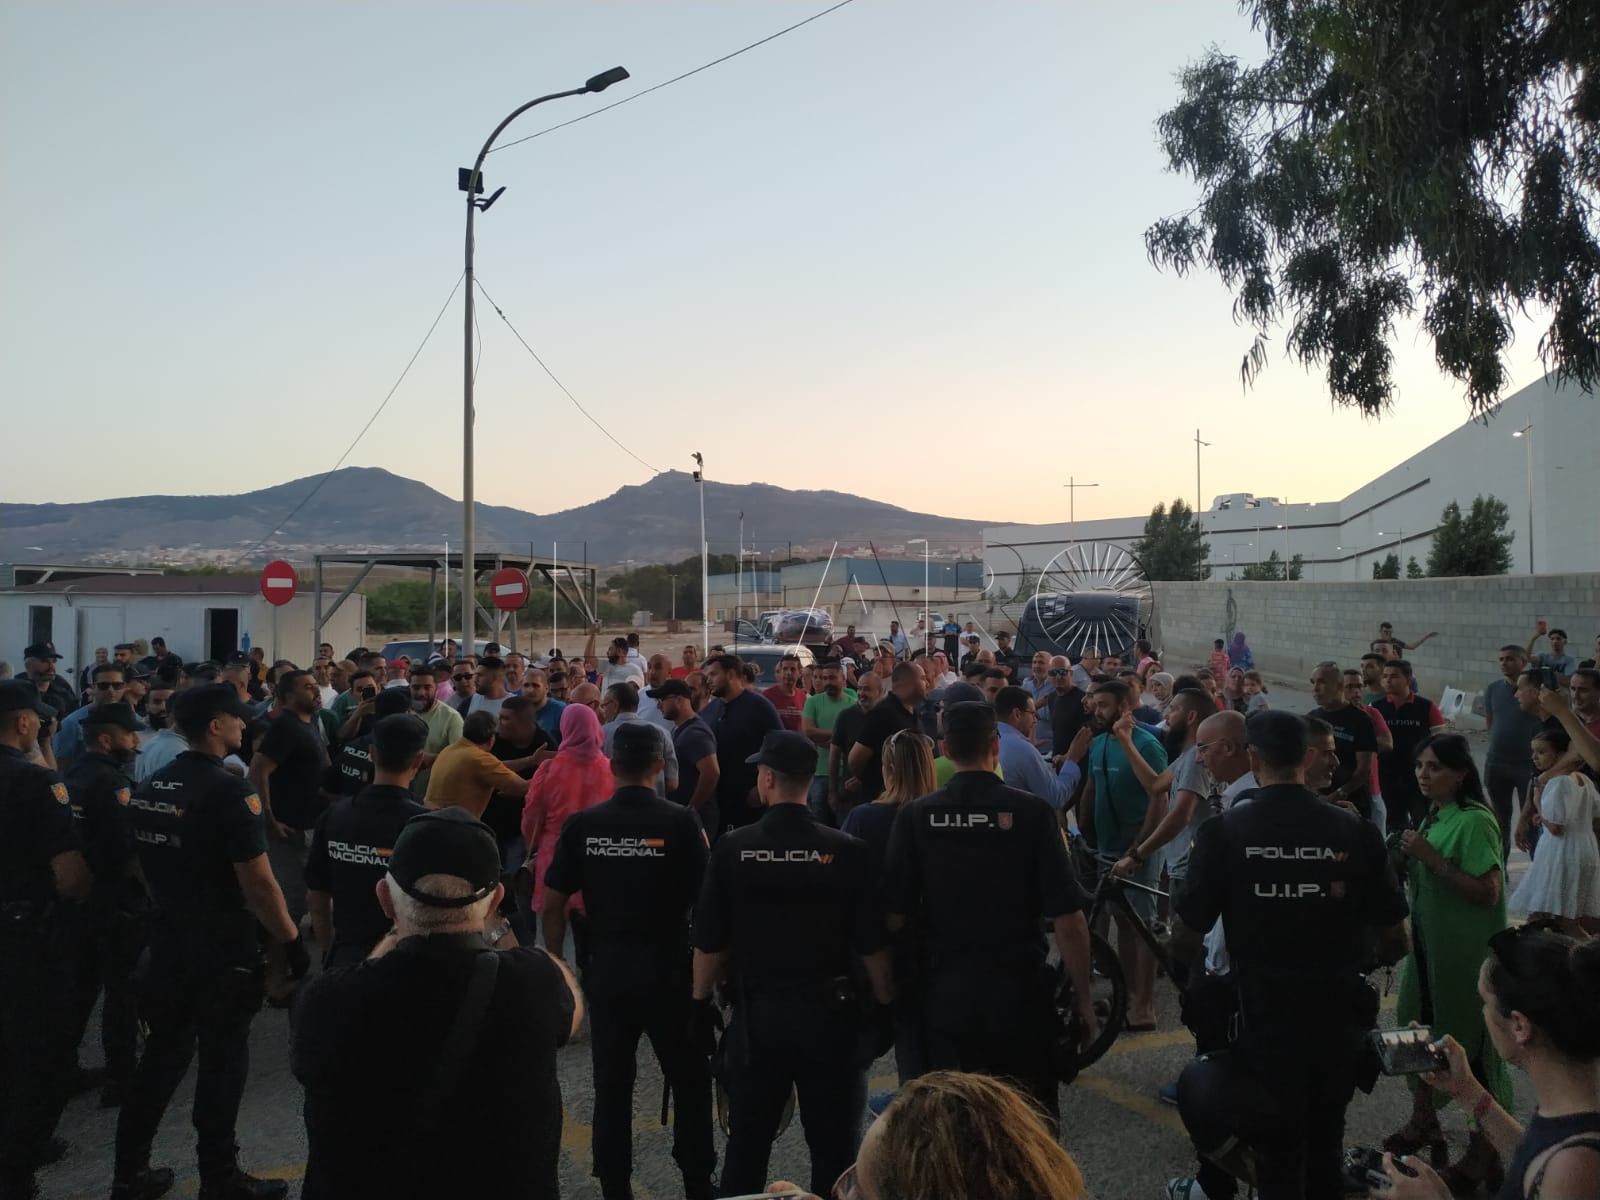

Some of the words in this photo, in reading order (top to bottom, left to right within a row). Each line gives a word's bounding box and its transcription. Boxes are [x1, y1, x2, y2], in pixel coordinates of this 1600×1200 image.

[929, 813, 995, 828] U.I.P.
[328, 840, 378, 856] POLICIA
[586, 837, 649, 848] POLICIA
[328, 850, 391, 867] NACIONAL
[586, 847, 665, 857] NACIONAL
[740, 850, 822, 862] POLICIA
[1245, 846, 1337, 861] POLICIA
[1254, 883, 1327, 898] U.I.P.
